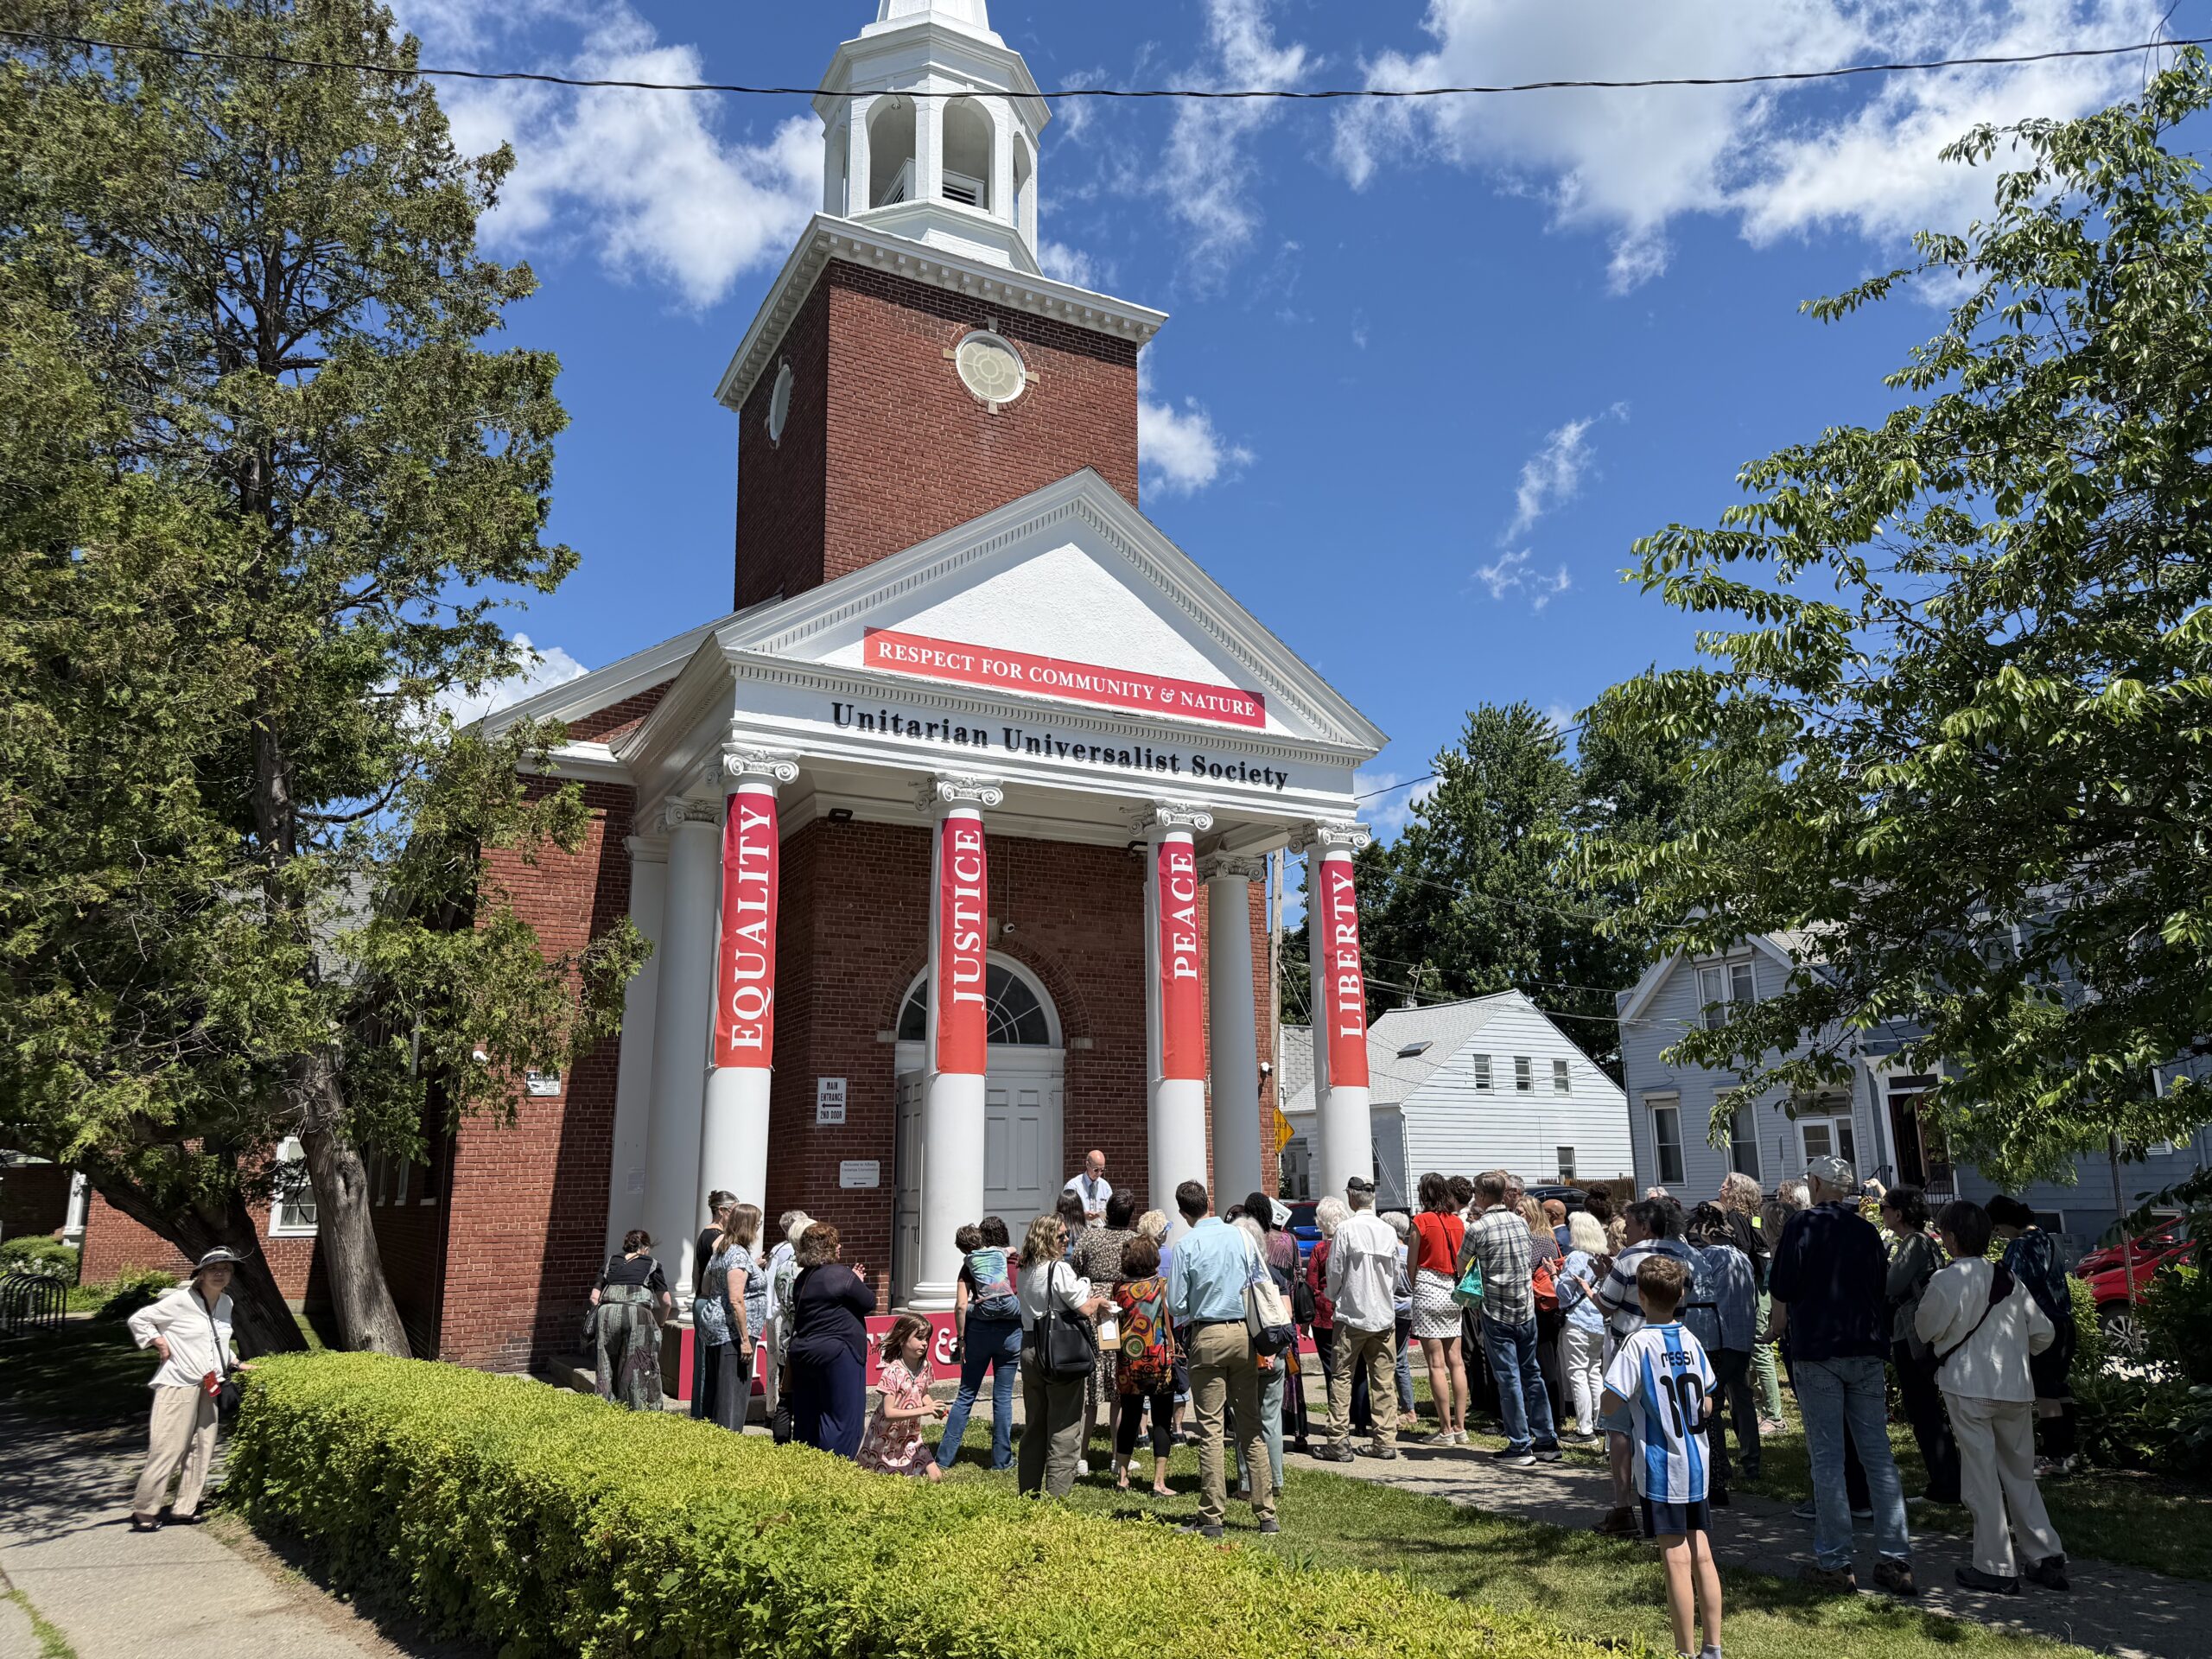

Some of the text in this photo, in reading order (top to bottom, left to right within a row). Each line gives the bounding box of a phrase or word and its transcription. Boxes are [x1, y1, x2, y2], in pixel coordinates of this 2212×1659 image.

[878, 641, 1255, 717] RESPECT FOR COMMUNITY & NATURE
[831, 702, 1289, 791] Unitarian Universalist Society
[731, 804, 772, 1051] EQUALITY
[953, 830, 985, 1011] JUSTICE
[1170, 852, 1198, 981] PEACE
[1332, 870, 1363, 1039] LIBERTY
[820, 1092, 843, 1102] ENTRANCE
[820, 1110, 842, 1119] 2ND DOOR
[826, 1081, 838, 1090] MAIN
[1661, 1351, 1695, 1368] MESSI
[1660, 1372, 1707, 1439] 10
